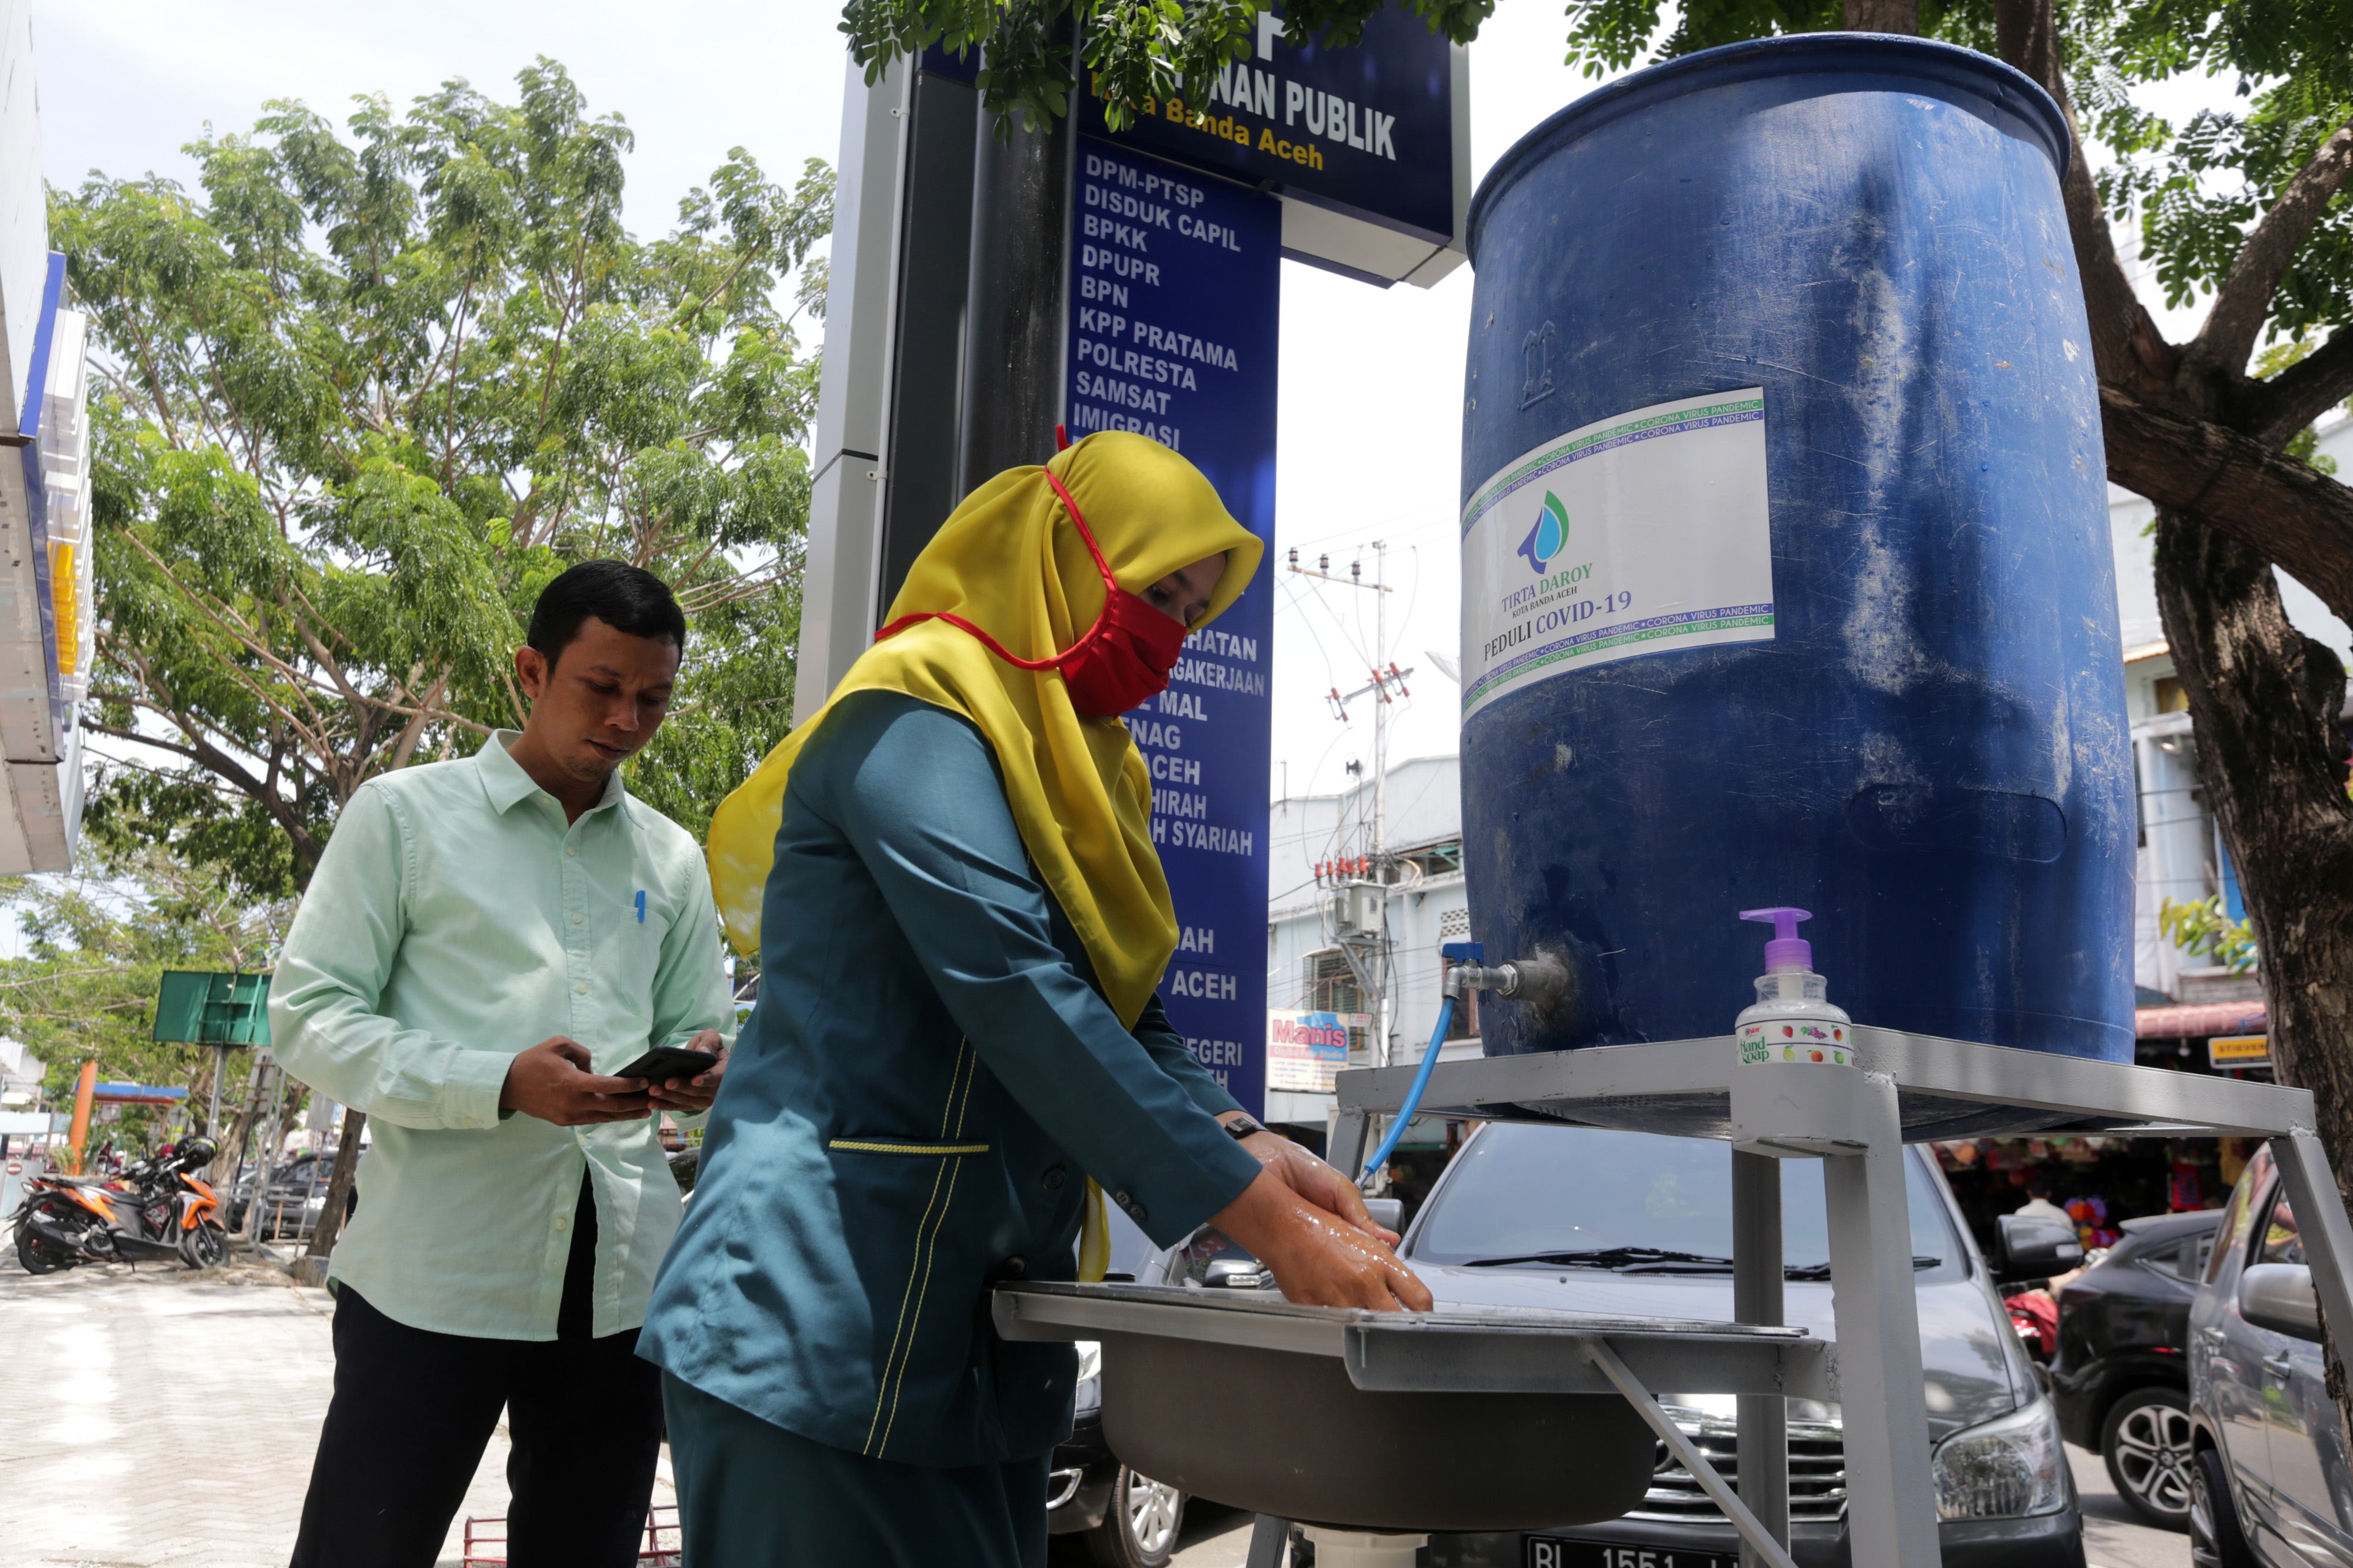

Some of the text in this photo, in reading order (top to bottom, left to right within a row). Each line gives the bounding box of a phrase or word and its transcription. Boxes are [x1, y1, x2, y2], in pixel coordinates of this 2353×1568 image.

[1166, 96, 1250, 146] Banda
[1258, 128, 1323, 171] Aceh
[1285, 80, 1397, 161] PUBLIK
[1086, 154, 1204, 208] DPM-PTSP
[1084, 213, 1148, 252] BPKK
[1085, 184, 1241, 252] DISDUK CAPIL
[1082, 244, 1160, 286] DPUPR
[1081, 275, 1128, 308] BPN
[1079, 306, 1238, 372] KPP PRATAMA
[1078, 338, 1197, 391] POLRESTA
[1076, 371, 1171, 415] SAMSAT
[1074, 403, 1180, 451] IMIGRASI
[1511, 461, 1537, 478] PANDEMIC
[1541, 446, 1570, 463] CORONA
[1572, 438, 1591, 449] VIRUS
[1594, 424, 1632, 442] PANDEMIC
[1640, 413, 1680, 428] CORONA
[1683, 408, 1708, 419] VIRUS
[1711, 401, 1758, 414] PANDEMIC
[1512, 471, 1538, 491] PANDEMIC
[1542, 456, 1571, 473] CORONA
[1572, 448, 1591, 460] VIRUS
[1594, 435, 1633, 453] PANDEMIC
[1641, 425, 1681, 439] CORONA
[1684, 419, 1709, 429] VIRUS
[1712, 412, 1759, 425] PANDEMIC
[1502, 563, 1593, 612] TIRTA DAROY
[1512, 586, 1577, 618] KOTA BANDA ACEH
[1182, 628, 1257, 662] HATAN
[1484, 590, 1632, 662] PEDULI COVID-19
[1513, 649, 1540, 666] PANDEMIC
[1544, 639, 1574, 653] CORONA
[1576, 632, 1597, 643] VIRUS
[1599, 622, 1639, 637] PANDEMIC
[1647, 614, 1688, 627] CORONA
[1691, 610, 1717, 620] VIRUS
[1720, 605, 1769, 616] PANDEMIC
[1513, 660, 1540, 676] PANDEMIC
[1544, 650, 1574, 664] CORONA
[1577, 642, 1597, 653] VIRUS
[1599, 633, 1639, 648] PANDEMIC
[1647, 625, 1688, 639] CORONA
[1691, 621, 1717, 631] VIRUS
[1721, 616, 1769, 628] PANDEMIC
[1159, 689, 1208, 722] MAL
[1172, 820, 1252, 856] SYARIAH
[1175, 926, 1214, 954] AH
[1171, 970, 1236, 1000] ACEH
[1184, 1037, 1242, 1066] EGERI
[1273, 1019, 1347, 1047] Manis
[1740, 1036, 1765, 1055] Hand
